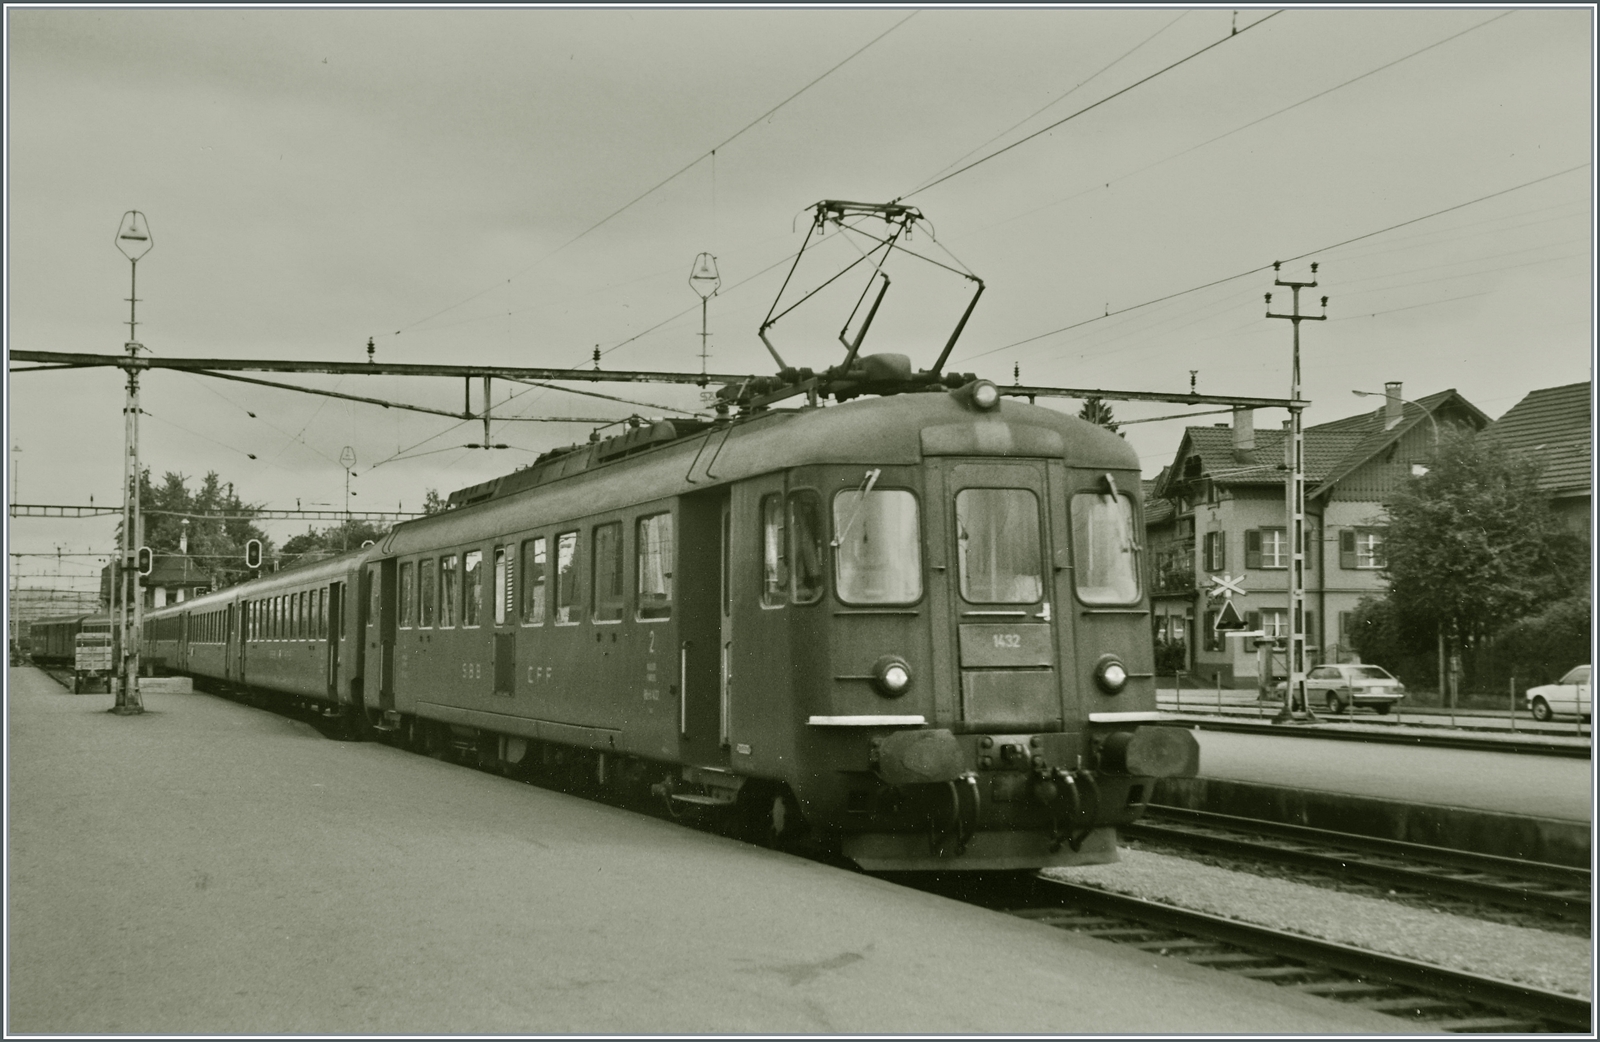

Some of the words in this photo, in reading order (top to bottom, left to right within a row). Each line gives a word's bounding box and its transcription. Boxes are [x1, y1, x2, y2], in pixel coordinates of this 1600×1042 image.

[649, 630, 655, 653] 2
[992, 633, 1021, 648] 1432
[462, 662, 481, 679] SBB
[527, 665, 552, 684] CFF
